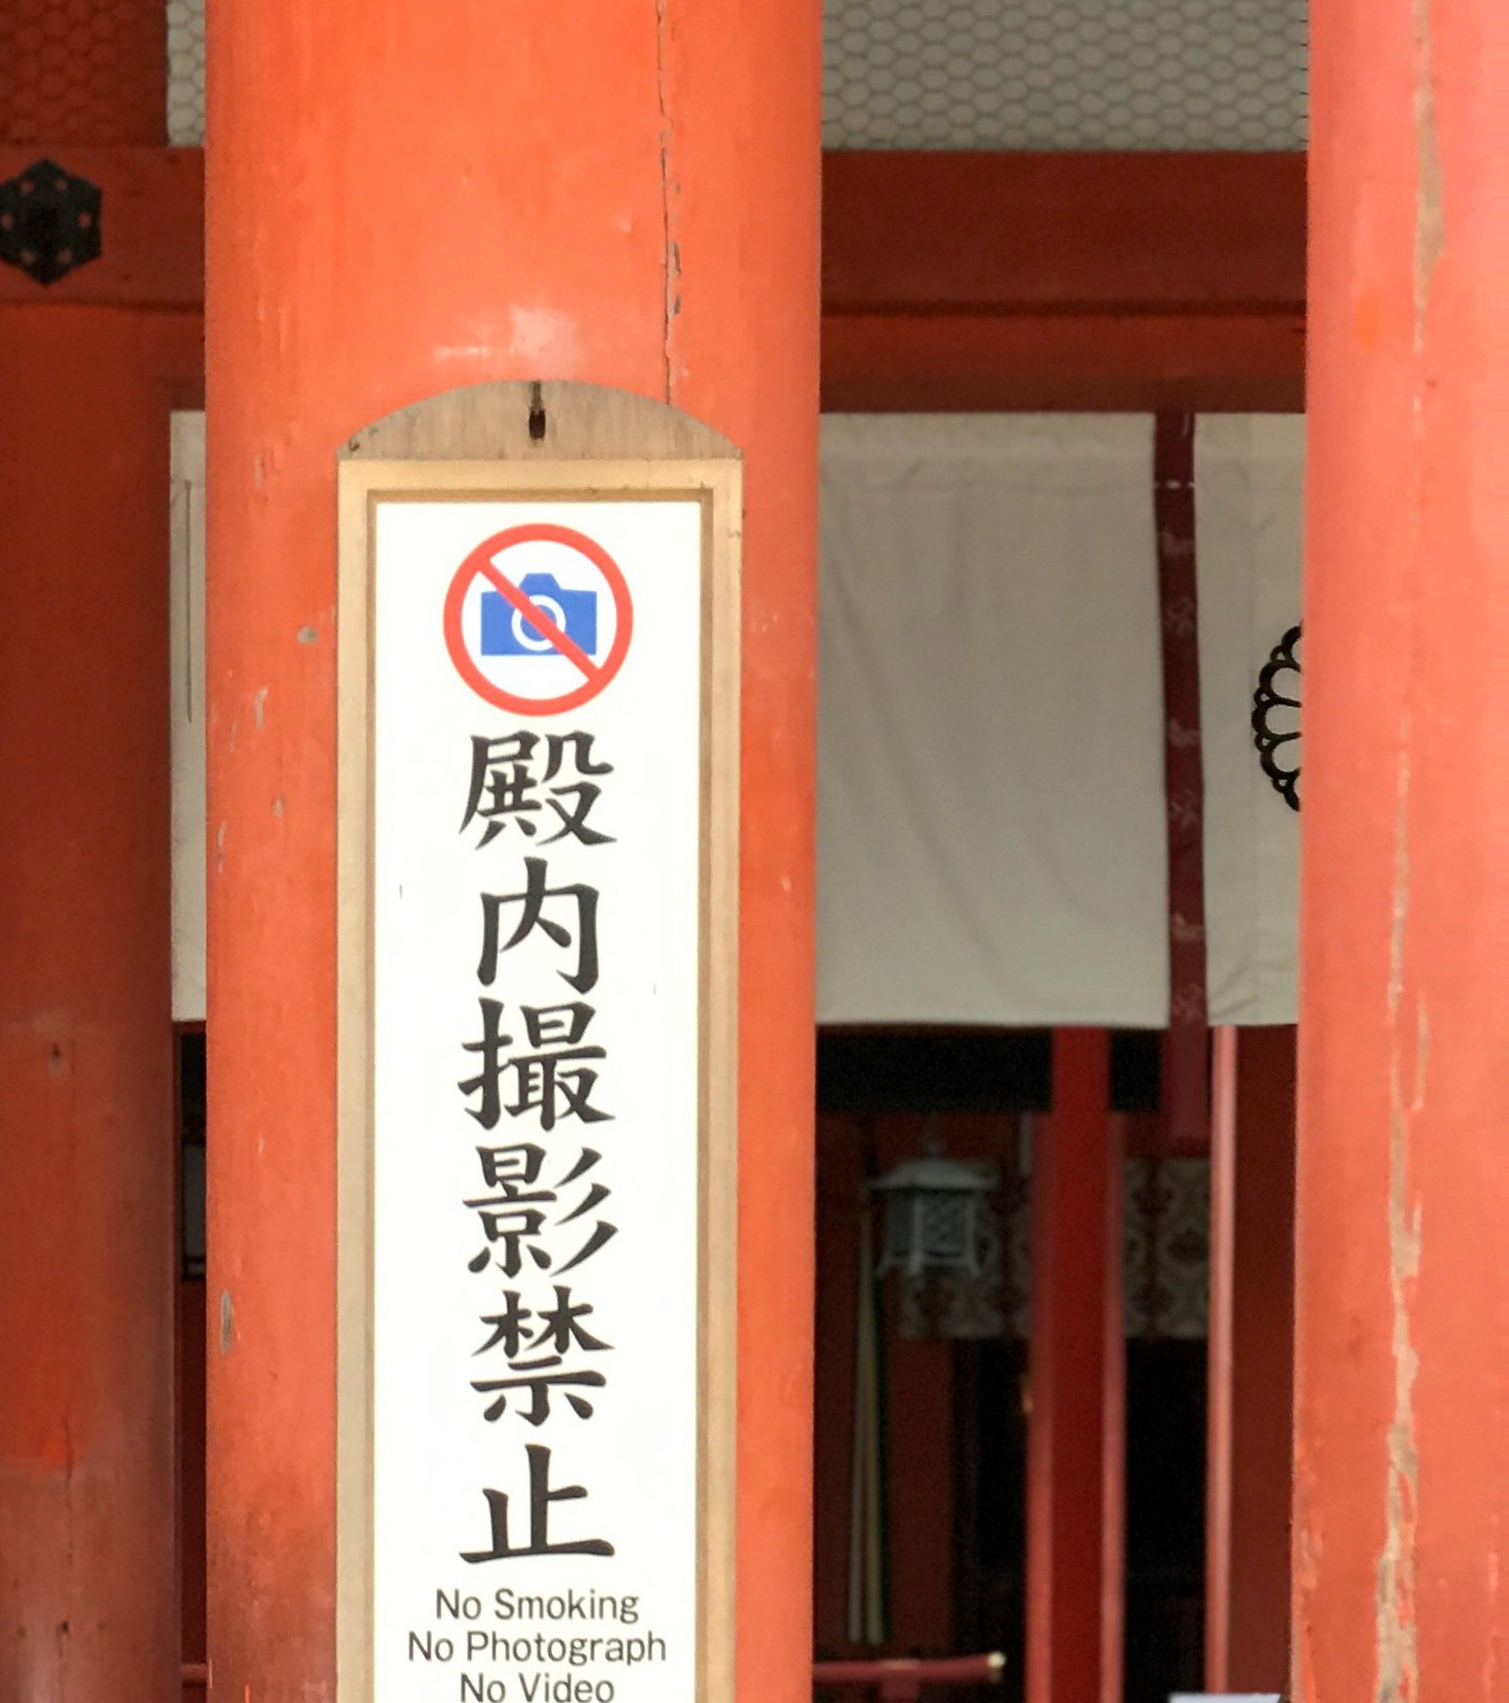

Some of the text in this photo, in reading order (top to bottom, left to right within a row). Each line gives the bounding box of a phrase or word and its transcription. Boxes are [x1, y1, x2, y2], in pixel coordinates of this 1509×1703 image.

[456, 729, 619, 1565] 殿内撮影禁止
[436, 1587, 639, 1625] No Smoking
[408, 1630, 666, 1667] No Photograph
[460, 1672, 506, 1703] No
